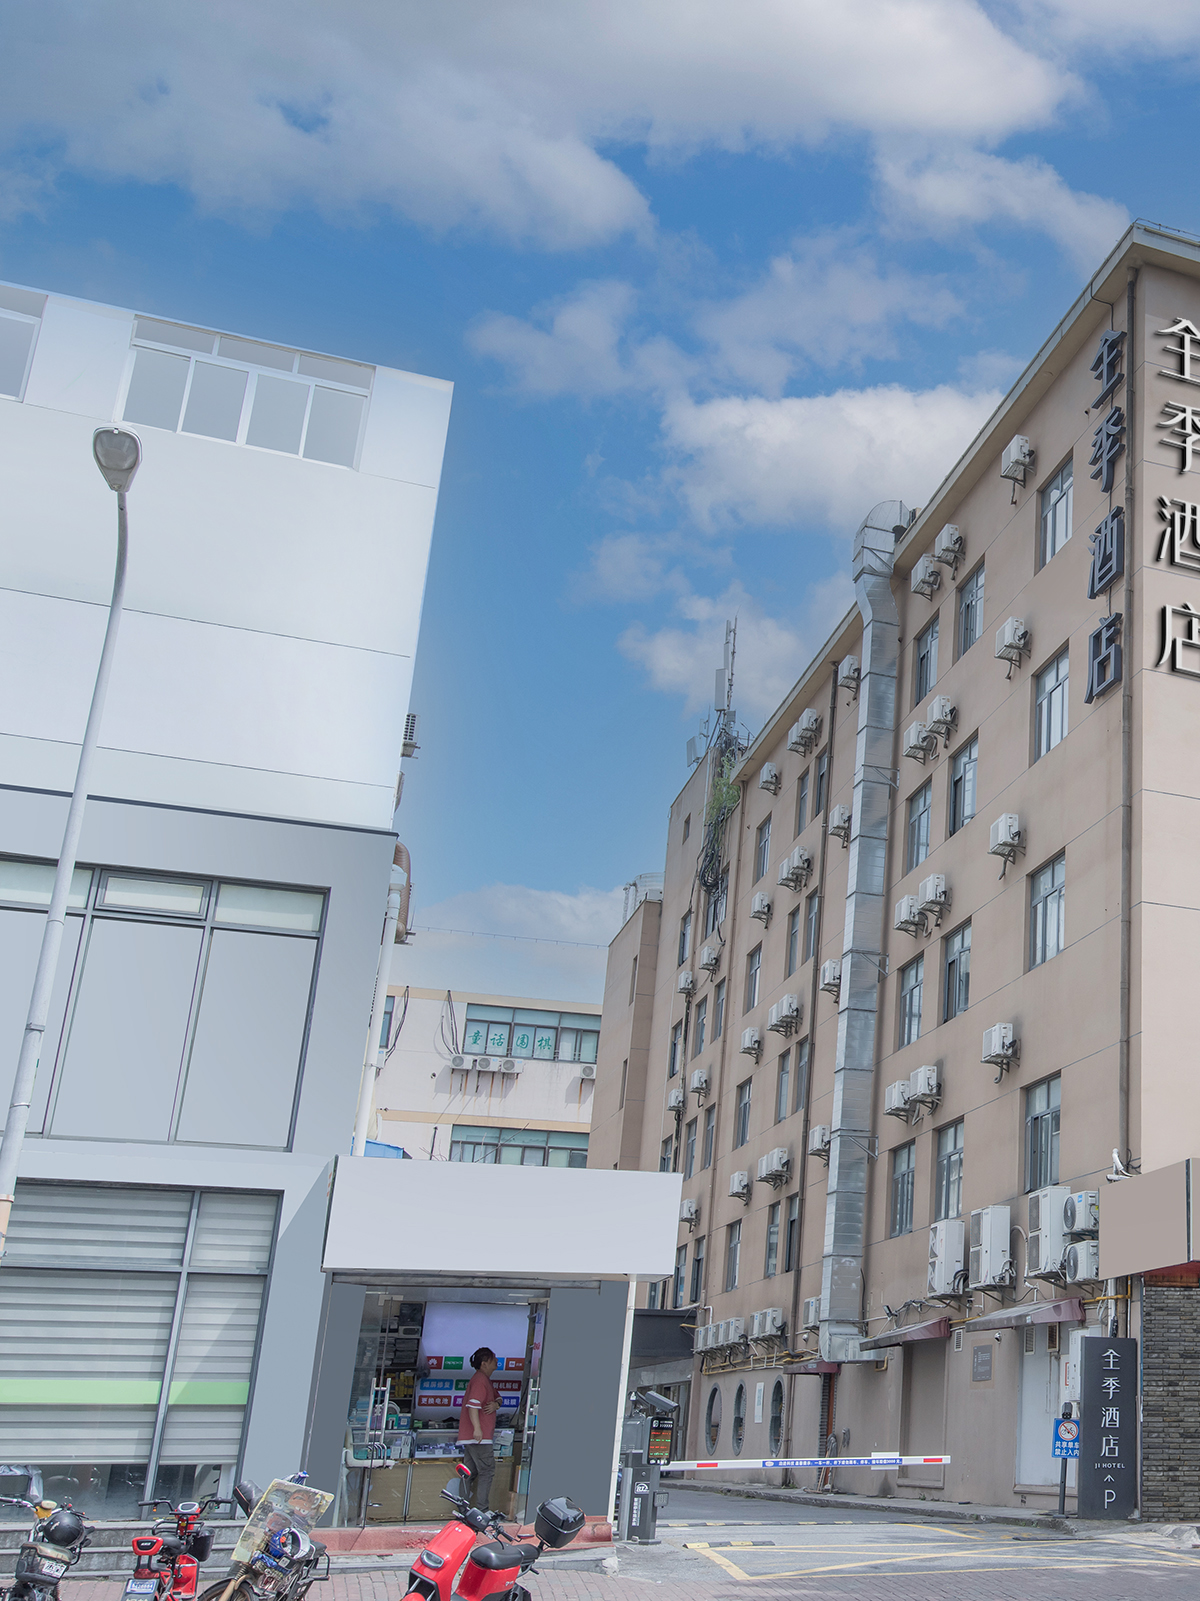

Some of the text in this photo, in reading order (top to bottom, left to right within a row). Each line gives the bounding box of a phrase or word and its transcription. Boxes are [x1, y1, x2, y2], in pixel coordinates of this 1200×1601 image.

[1084, 328, 1128, 704] 全季酒店
[1100, 1348, 1122, 1458] 全季酒店
[1054, 1448, 1080, 1457] 禁止入内
[1104, 1489, 1117, 1510] P
